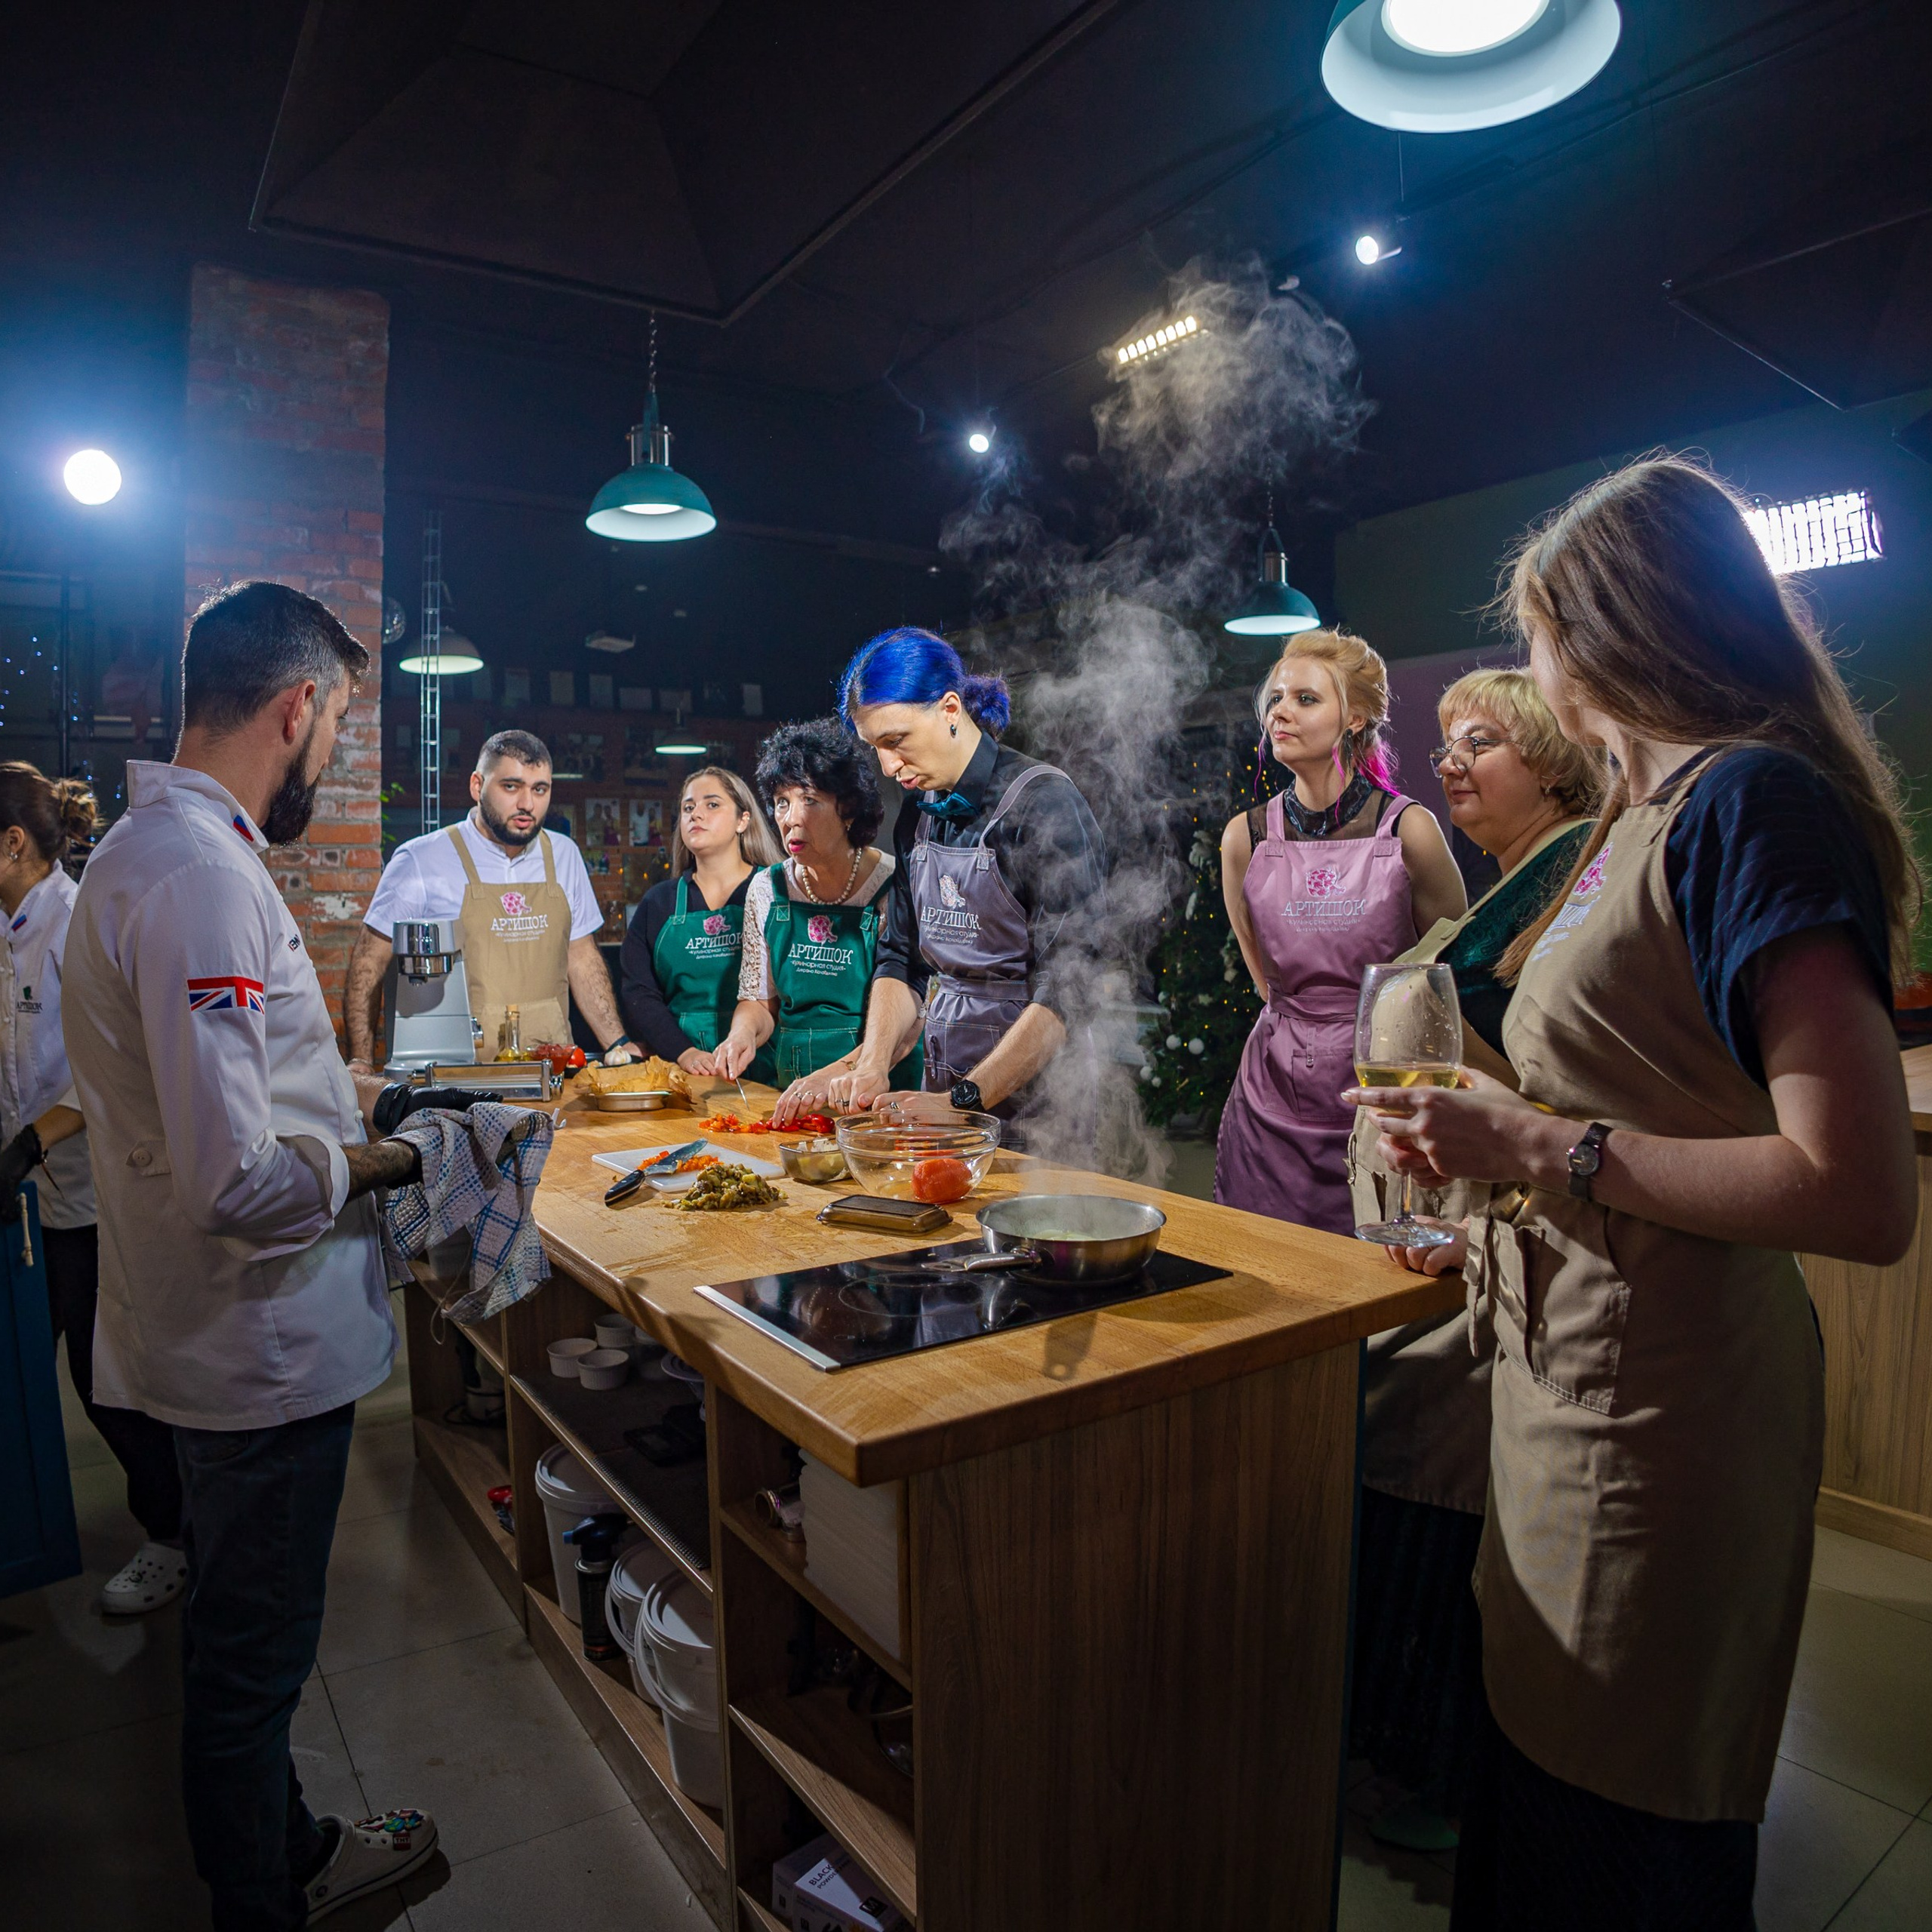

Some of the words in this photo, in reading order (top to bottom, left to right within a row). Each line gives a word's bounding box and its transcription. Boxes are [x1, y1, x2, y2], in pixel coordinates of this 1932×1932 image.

[1281, 898, 1367, 917] АРТИШОК
[491, 914, 549, 931] АРТИШОК
[921, 906, 981, 930] АРТИШОК
[685, 932, 743, 949] АРТИШОК
[787, 943, 854, 964] АРТИШОК
[808, 1863, 835, 1886] BLACK
